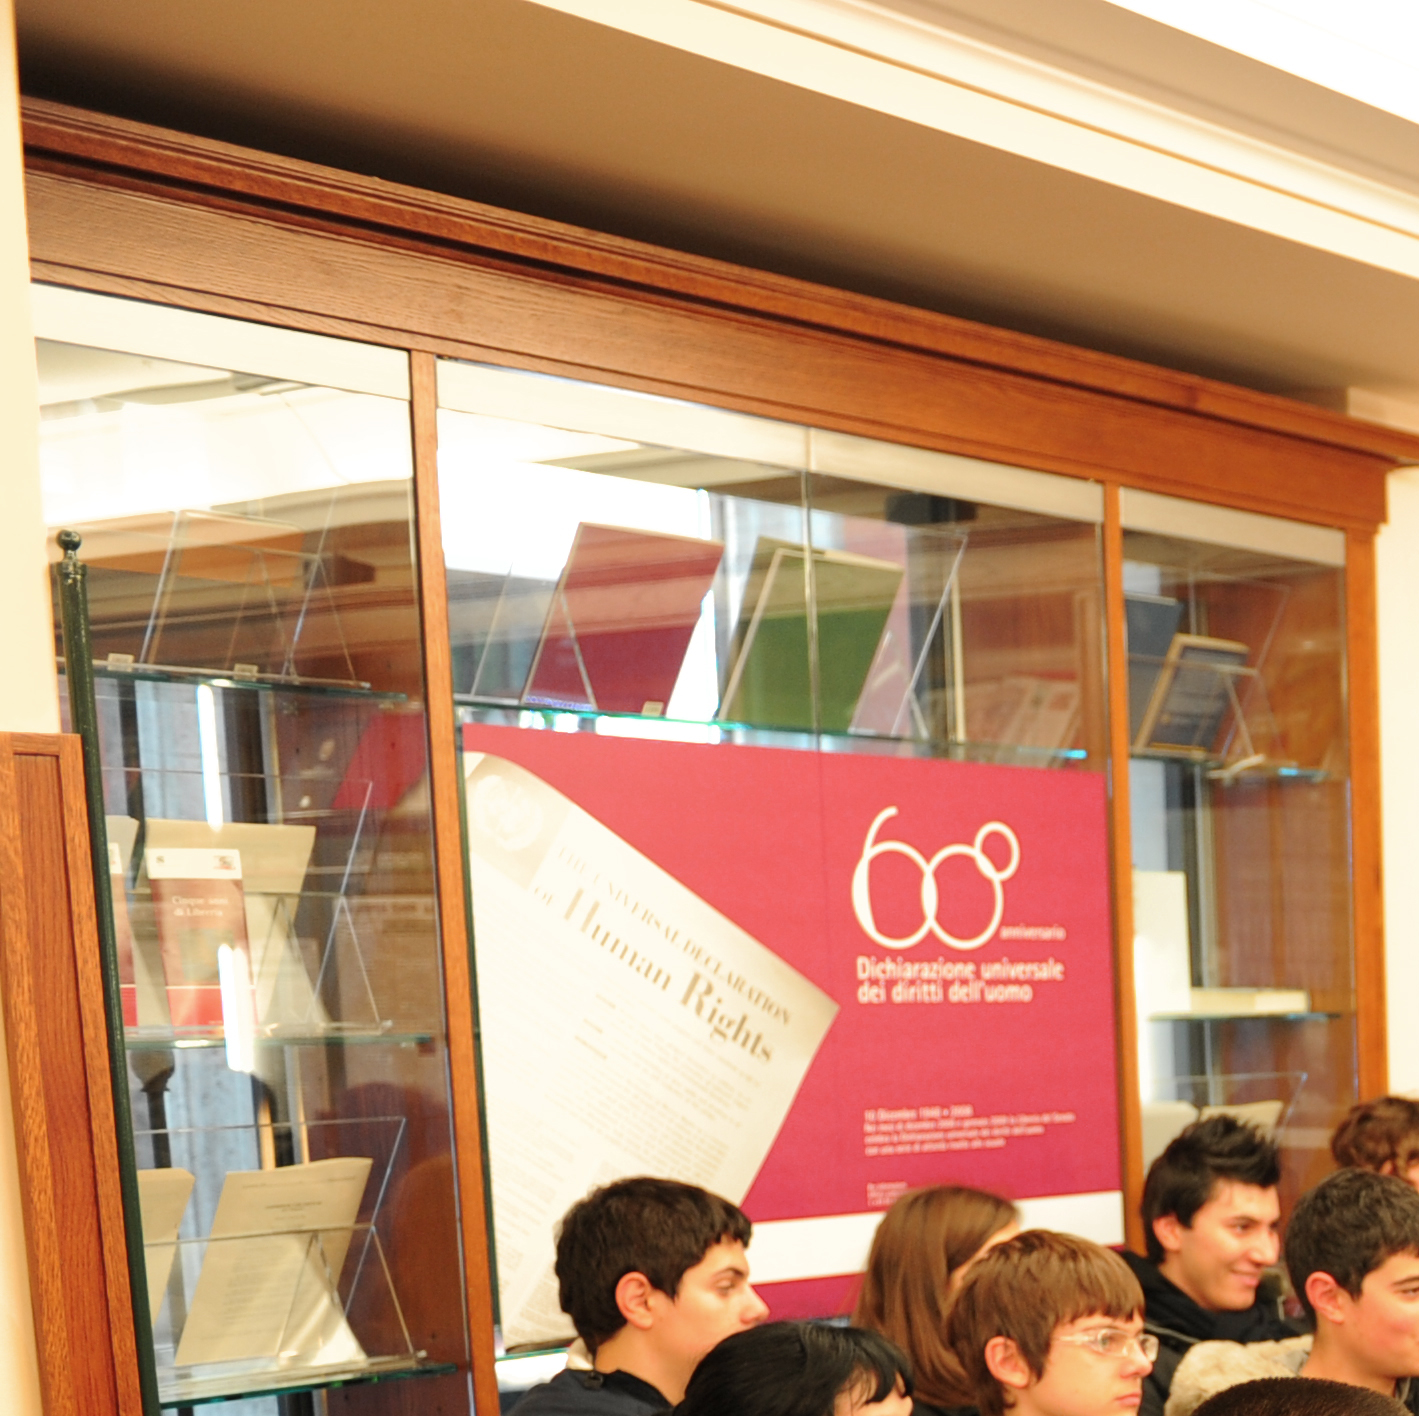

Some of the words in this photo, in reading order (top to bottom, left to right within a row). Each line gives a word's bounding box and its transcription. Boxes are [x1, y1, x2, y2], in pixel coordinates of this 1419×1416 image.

[1001, 926, 1065, 941] anniversario
[593, 871, 681, 944] UNIVERSAL
[682, 939, 792, 1028] DECLARATION
[562, 886, 673, 991] Human
[680, 970, 775, 1063] Rights
[856, 954, 976, 983] Dichiarazione
[980, 956, 1064, 982] universale
[858, 980, 887, 1004] dei
[892, 980, 944, 1004] diritti
[950, 979, 1034, 1003] dell'uomo
